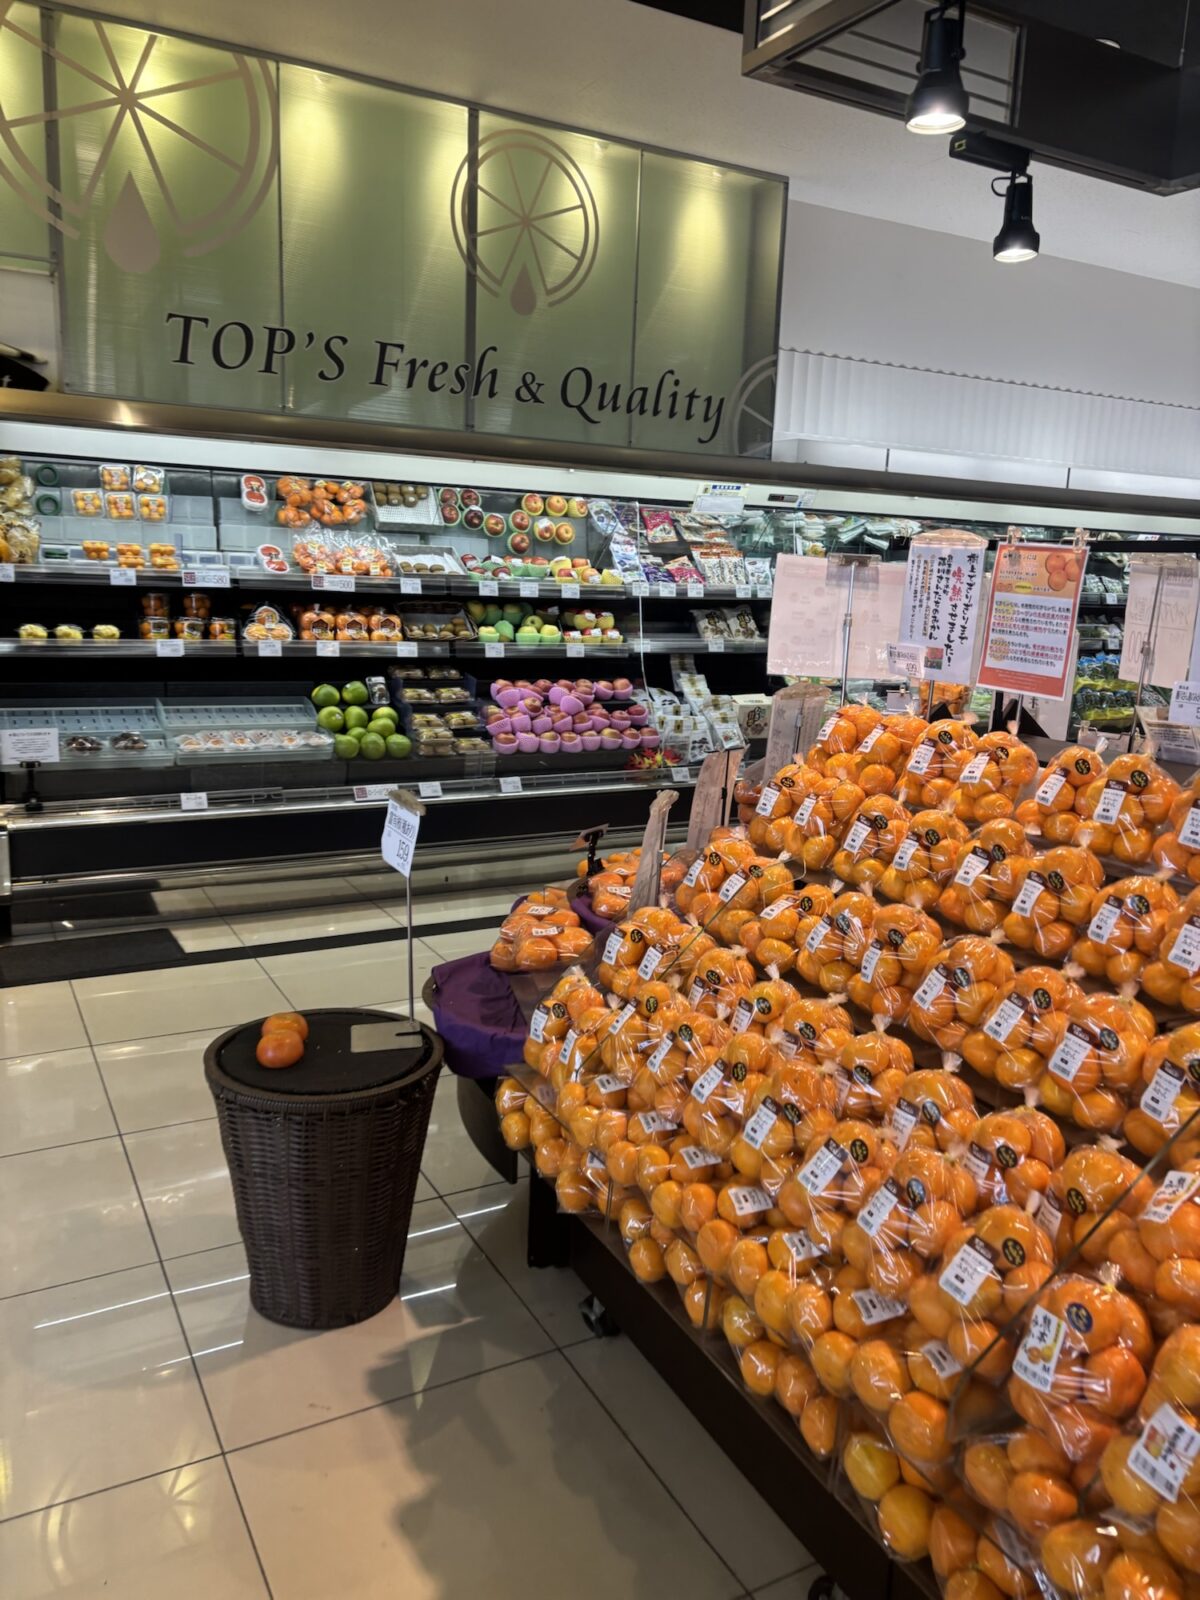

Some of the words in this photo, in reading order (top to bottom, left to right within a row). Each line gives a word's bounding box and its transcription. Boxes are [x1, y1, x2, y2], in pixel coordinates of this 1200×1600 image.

[166, 313, 348, 381] TOP'S
[369, 340, 499, 399] Fresh
[515, 371, 545, 404] &
[560, 367, 725, 444] Quality
